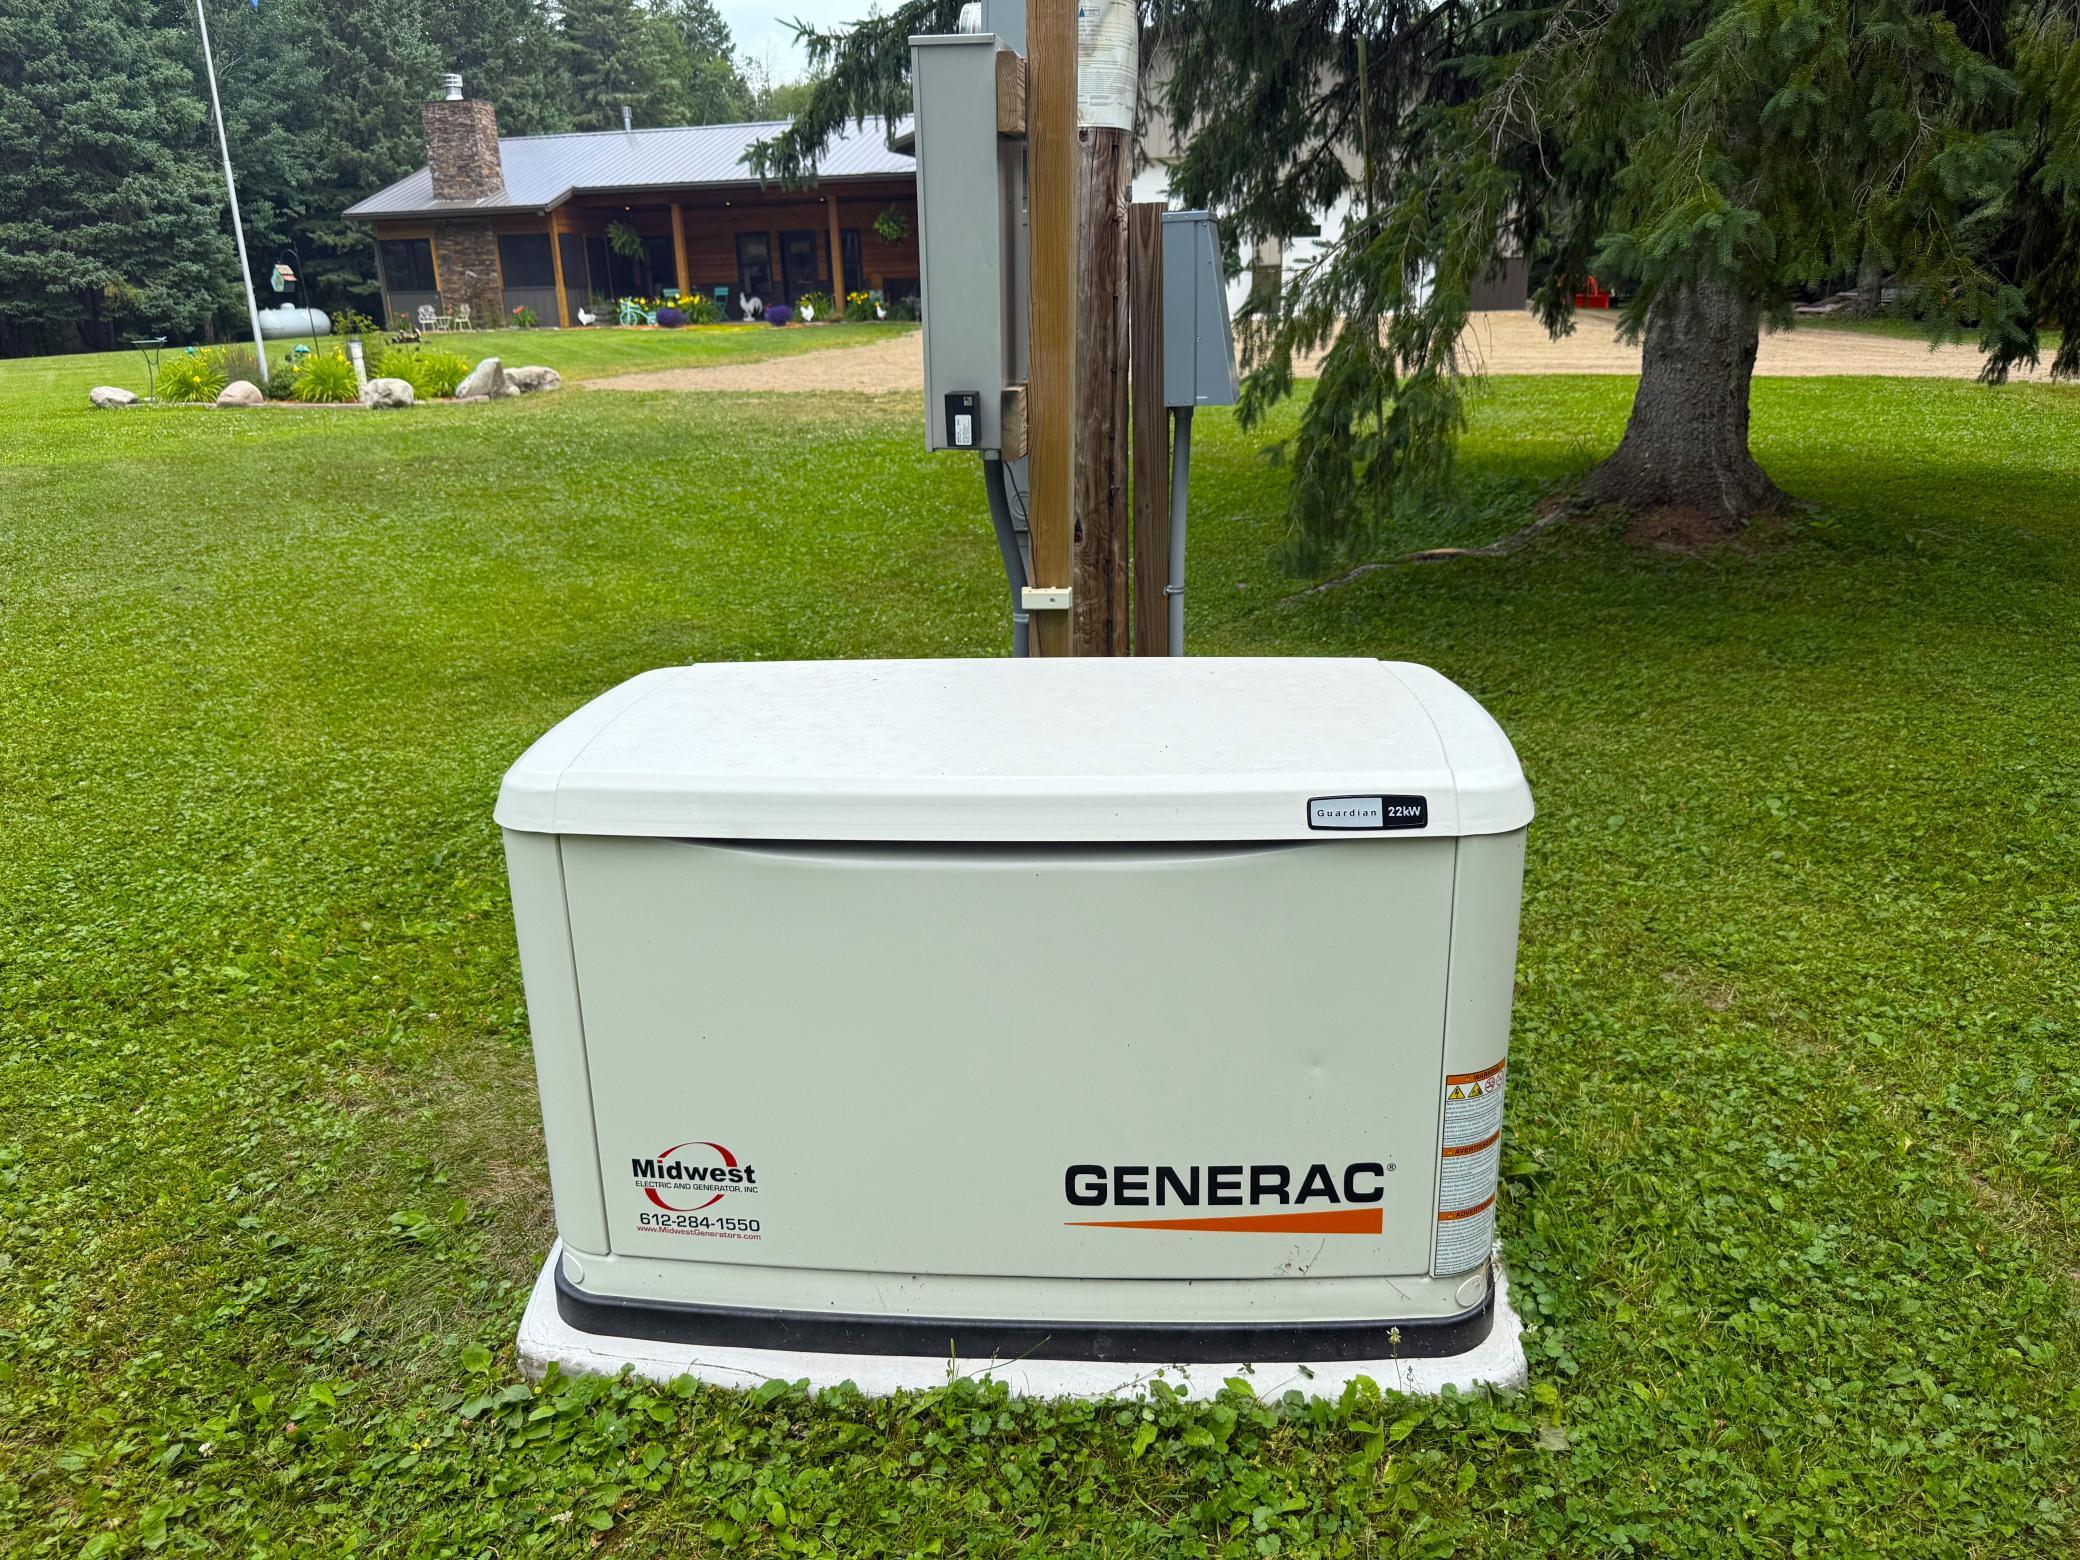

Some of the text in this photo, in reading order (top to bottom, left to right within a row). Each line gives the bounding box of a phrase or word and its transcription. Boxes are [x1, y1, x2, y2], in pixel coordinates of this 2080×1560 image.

[1317, 806, 1421, 818] Guardian 22kW
[632, 1158, 756, 1184] Midwest
[635, 1180, 759, 1194] ELECTRIC AND GENERATOR, INC
[1064, 1162, 1385, 1207] GENERAC
[640, 1212, 760, 1232] 612-284-1550
[636, 1226, 761, 1241] www.MidwestGenerators.com
